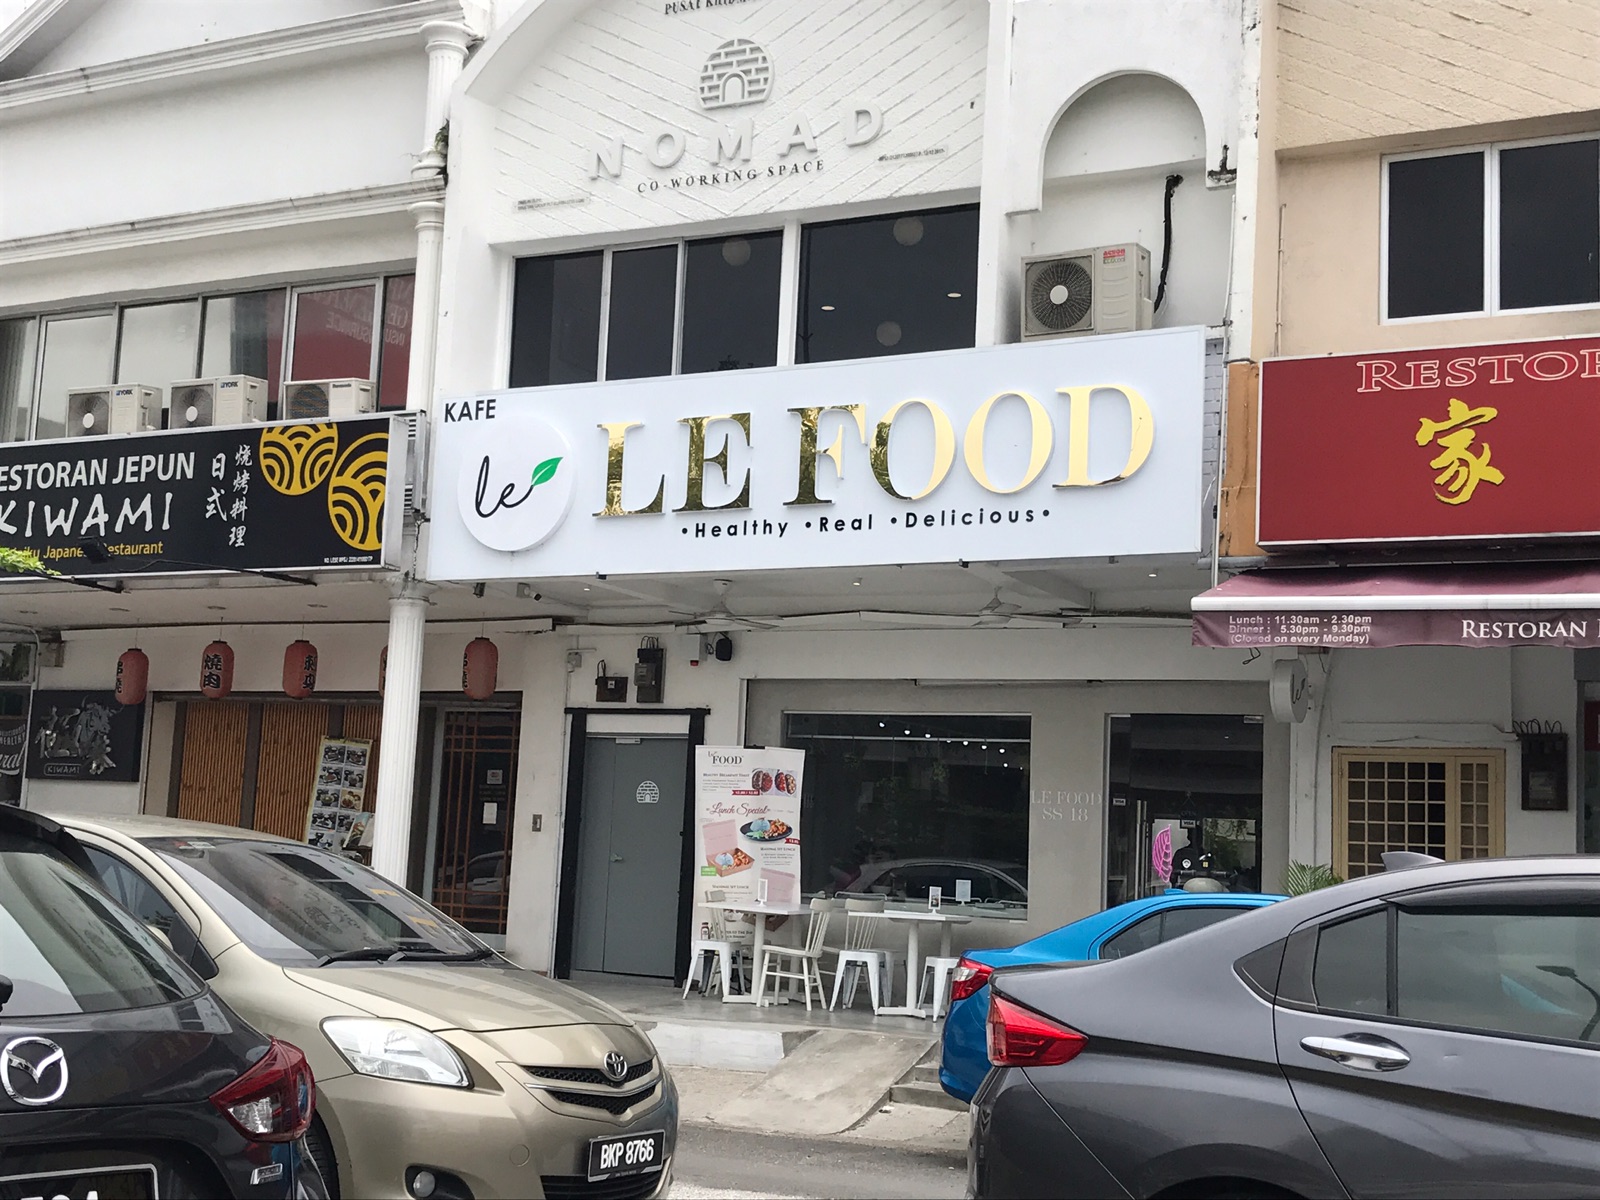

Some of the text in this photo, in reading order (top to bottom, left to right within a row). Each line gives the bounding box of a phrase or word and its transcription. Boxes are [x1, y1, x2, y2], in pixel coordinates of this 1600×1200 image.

[587, 103, 885, 181] NOMAD
[637, 159, 825, 193] CO-WORKING SPACE
[444, 399, 497, 423] KAFE
[592, 384, 1156, 518] LE FOOD
[1415, 398, 1506, 505] 家
[112, 451, 196, 485] JEPUN
[205, 452, 228, 521] 日式
[695, 507, 1034, 539] Healthy Real Delicious
[43, 545, 90, 561] Japane
[1229, 615, 1372, 626] Lunch 11.30am 2.30pm
[1229, 624, 1371, 635] Dinner 5.30pm 9.30pm
[1461, 619, 1588, 639] RESTORAN
[1231, 634, 1271, 644] (Closed
[1290, 636, 1320, 644] every
[1322, 633, 1370, 644] Monday)
[47, 765, 80, 774] KIWAMI
[712, 756, 743, 765] FOOD
[1031, 790, 1103, 806] LE FOOD
[709, 802, 768, 817] Lunch Special
[1042, 807, 1089, 822] SS 18
[600, 1138, 655, 1169] BKP 8766
